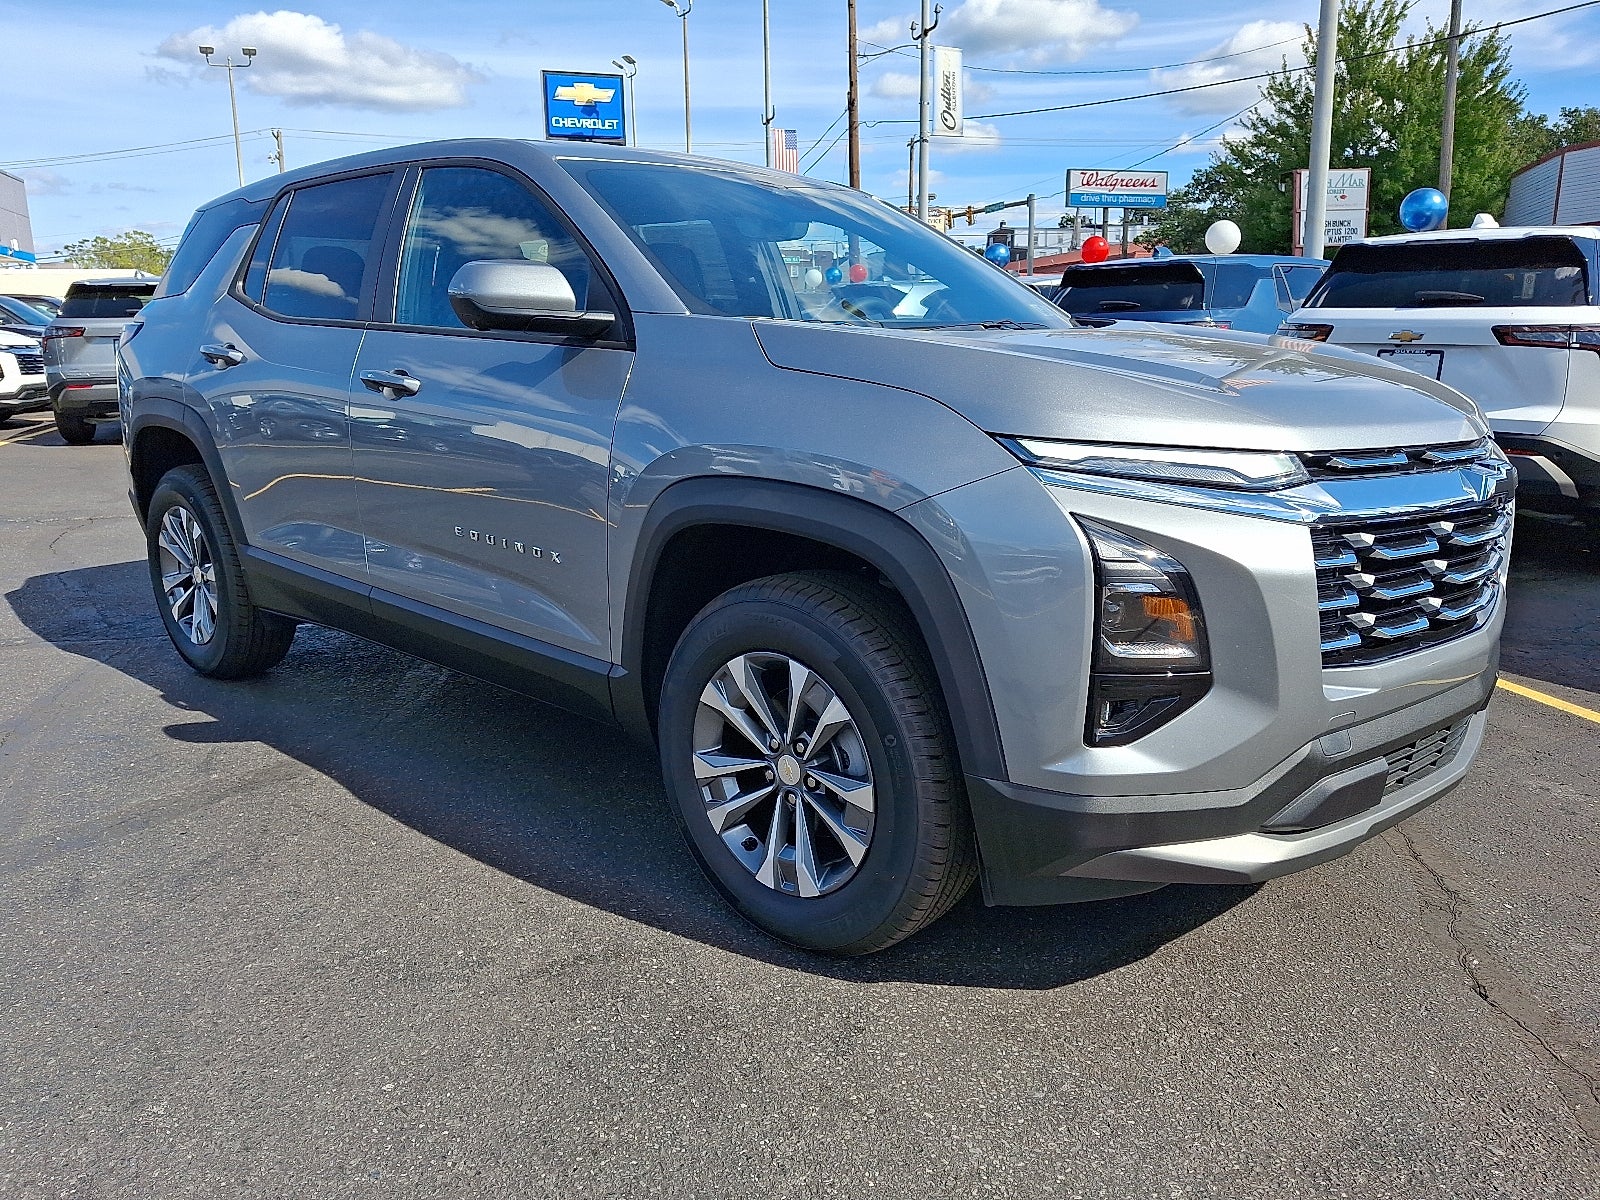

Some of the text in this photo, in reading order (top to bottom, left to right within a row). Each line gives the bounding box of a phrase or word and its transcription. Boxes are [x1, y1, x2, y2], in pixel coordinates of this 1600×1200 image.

[940, 70, 956, 131] Outten
[551, 116, 619, 130] CHEVROLET
[1080, 171, 1158, 192] Walgreens
[1081, 193, 1156, 205] drive thru pharmacy
[1344, 227, 1358, 235] 1200
[454, 526, 561, 564] EQUINOX
